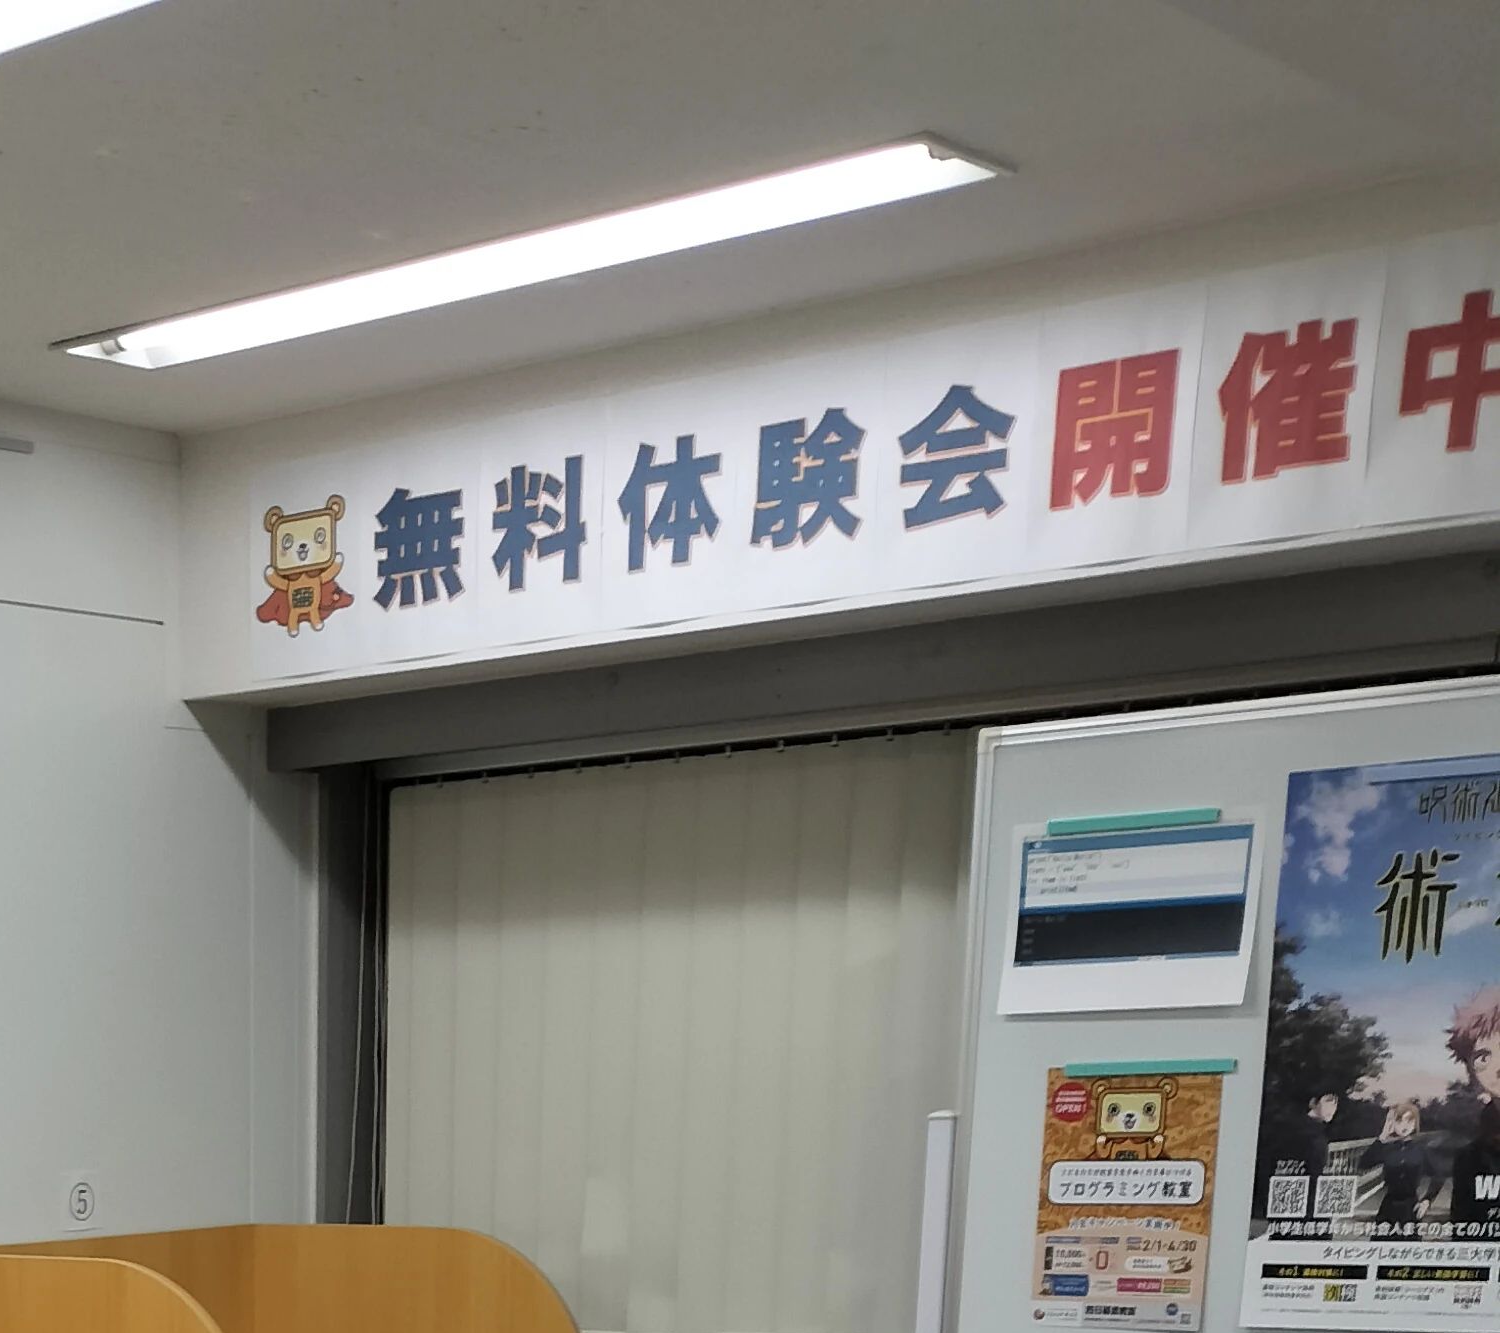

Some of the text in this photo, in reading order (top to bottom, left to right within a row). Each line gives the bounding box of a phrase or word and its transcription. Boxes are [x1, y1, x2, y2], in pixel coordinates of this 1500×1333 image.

[372, 287, 1500, 613] 無料体験会開催中
[1059, 1180, 1193, 1198] プログラミング教室
